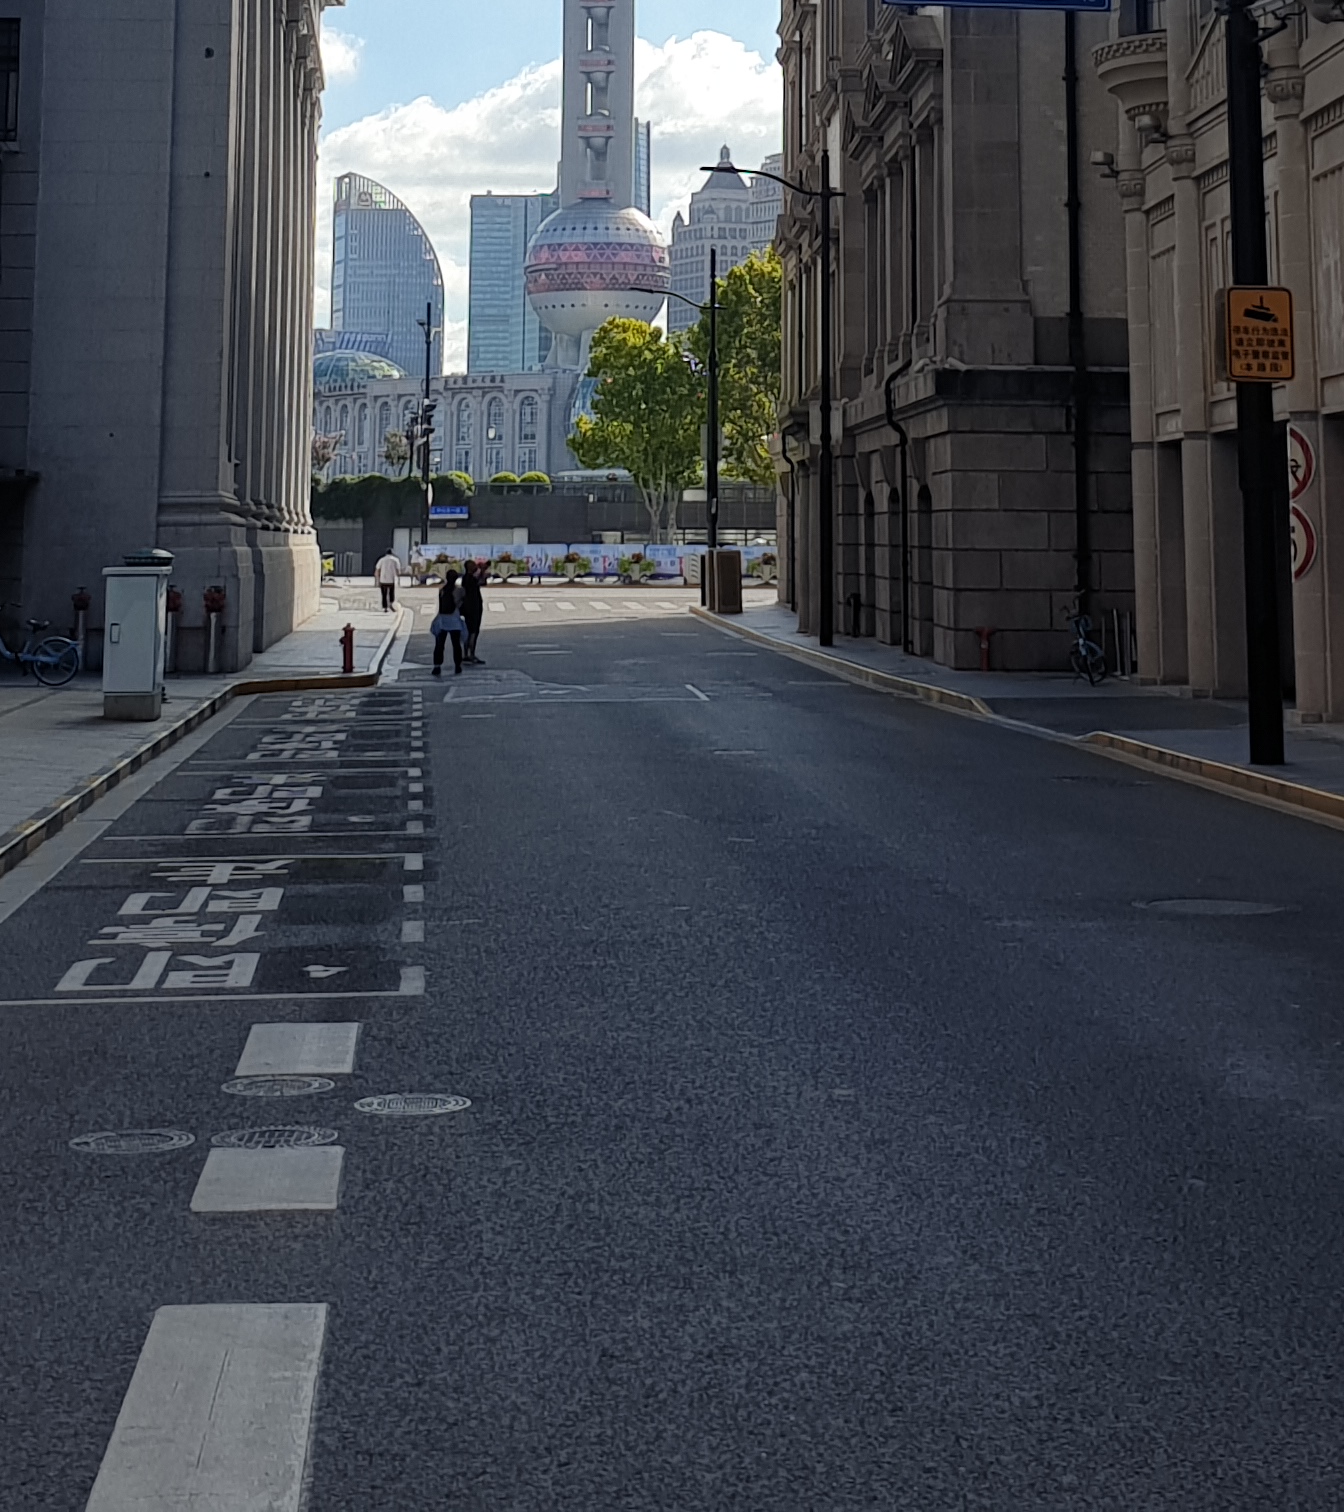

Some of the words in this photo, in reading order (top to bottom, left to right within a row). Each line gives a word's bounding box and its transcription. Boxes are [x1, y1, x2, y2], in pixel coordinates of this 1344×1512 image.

[183, 773, 328, 834] 即停即走
[53, 859, 296, 992] 即停即走
